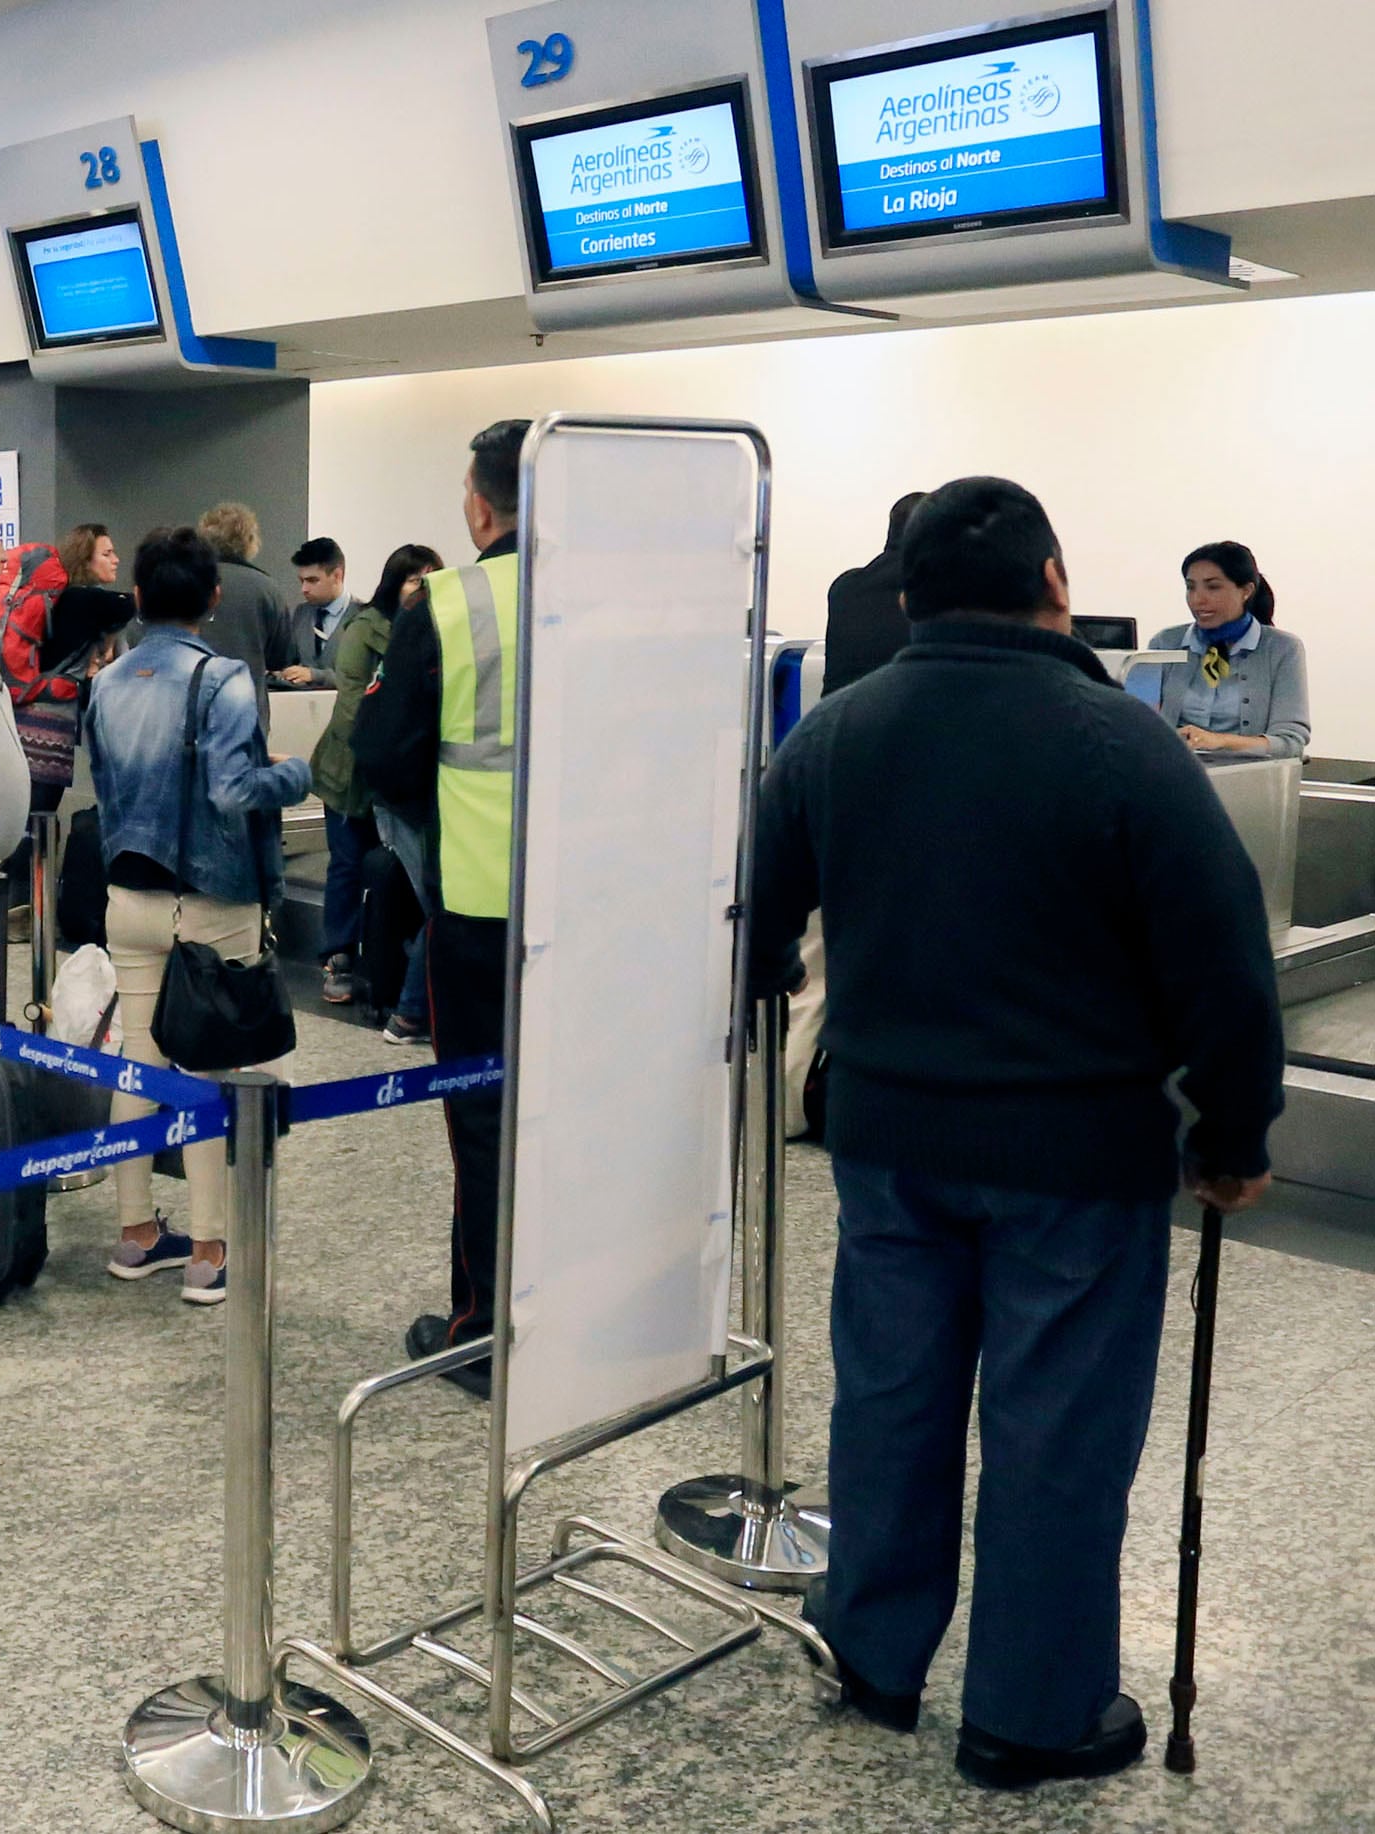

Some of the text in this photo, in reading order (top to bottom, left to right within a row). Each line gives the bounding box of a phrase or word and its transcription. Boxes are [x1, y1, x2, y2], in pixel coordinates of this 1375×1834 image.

[517, 32, 574, 88] 29
[879, 79, 1012, 120] Aerolíneas
[876, 104, 1009, 145] Argentinas
[80, 146, 121, 189] 28
[571, 140, 672, 174] Aerolíneas
[880, 149, 1001, 180] Destinos al Norte
[570, 162, 673, 195] Argentinas
[576, 200, 668, 225] Destinos al Norte
[883, 186, 958, 214] La Rioja
[581, 231, 656, 255] Corrientes
